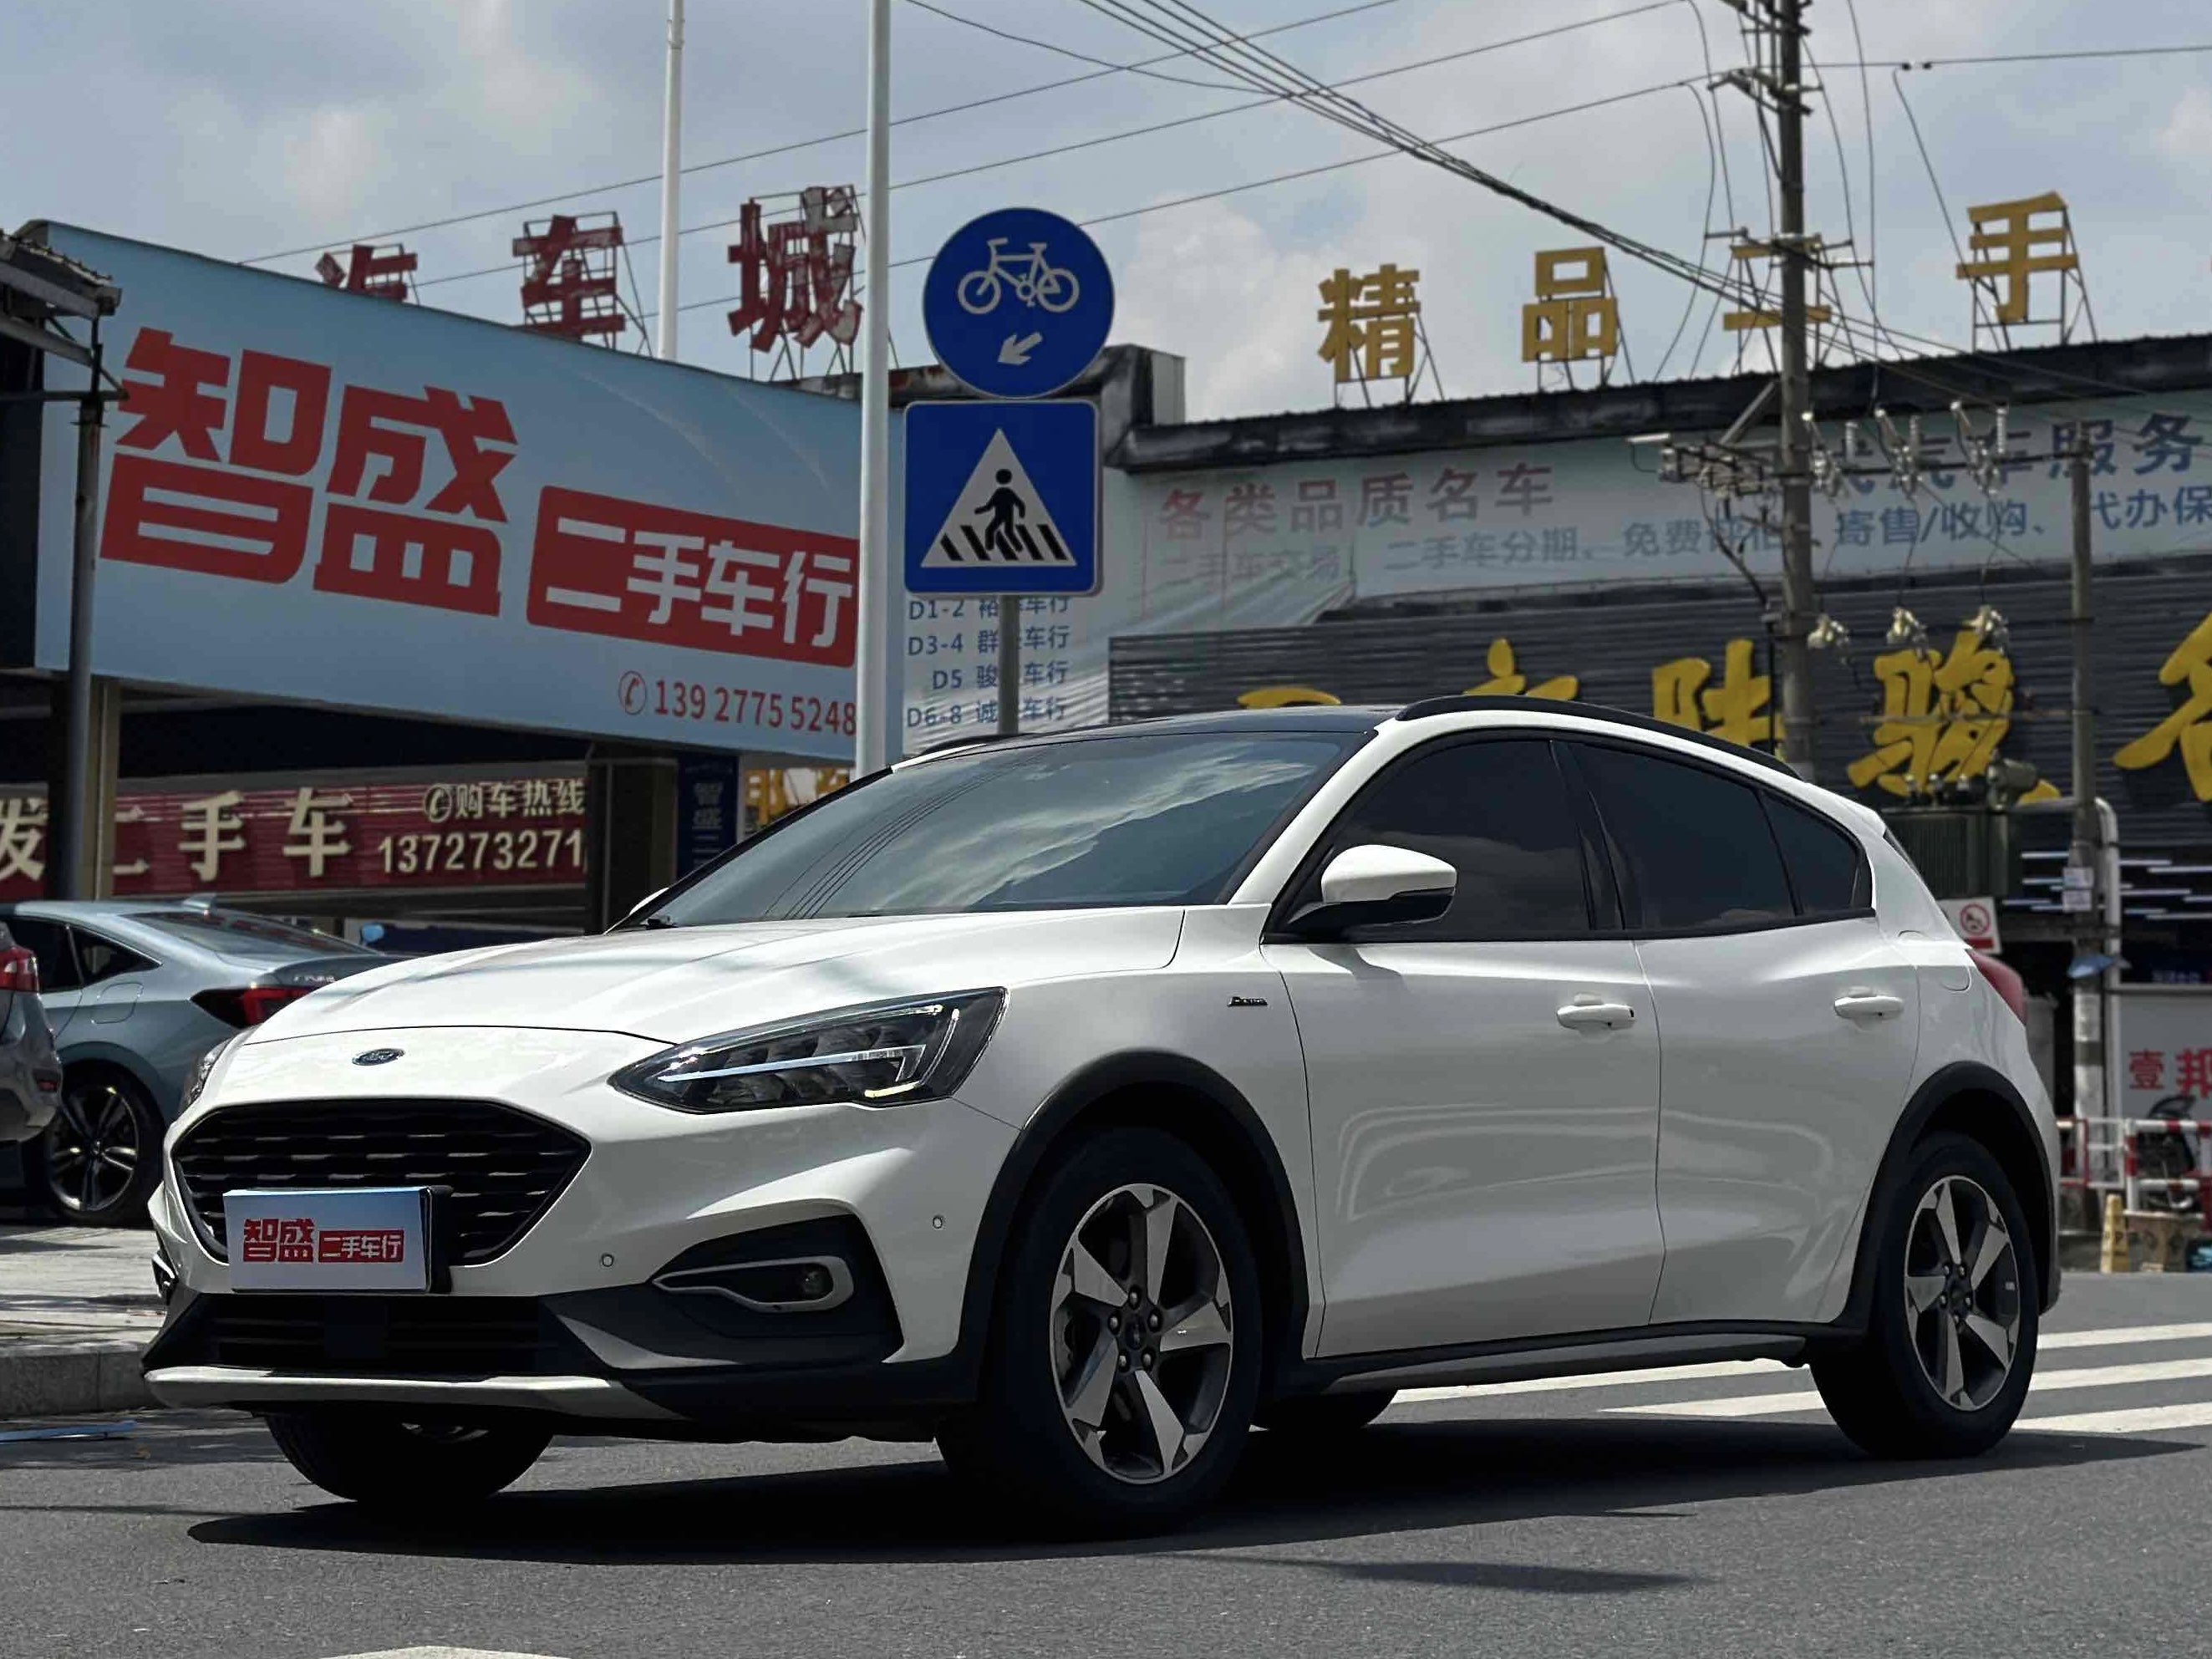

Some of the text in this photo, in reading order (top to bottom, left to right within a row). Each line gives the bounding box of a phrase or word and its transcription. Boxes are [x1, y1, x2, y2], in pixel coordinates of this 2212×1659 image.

[1318, 191, 2079, 383] 精品二手
[99, 326, 854, 649] 智盛 二手车行
[1159, 461, 1554, 540] 各类品质名车
[909, 598, 965, 620] D1-2
[908, 624, 1070, 656] D3-4 群车行
[932, 659, 1070, 690] D5 骏车行
[654, 679, 857, 736] 139 2775 5248
[976, 695, 1066, 725] 诚车行
[455, 778, 585, 820] 购车热线
[378, 827, 587, 875] 137273271
[242, 1218, 402, 1264] 智盛 二手车行
